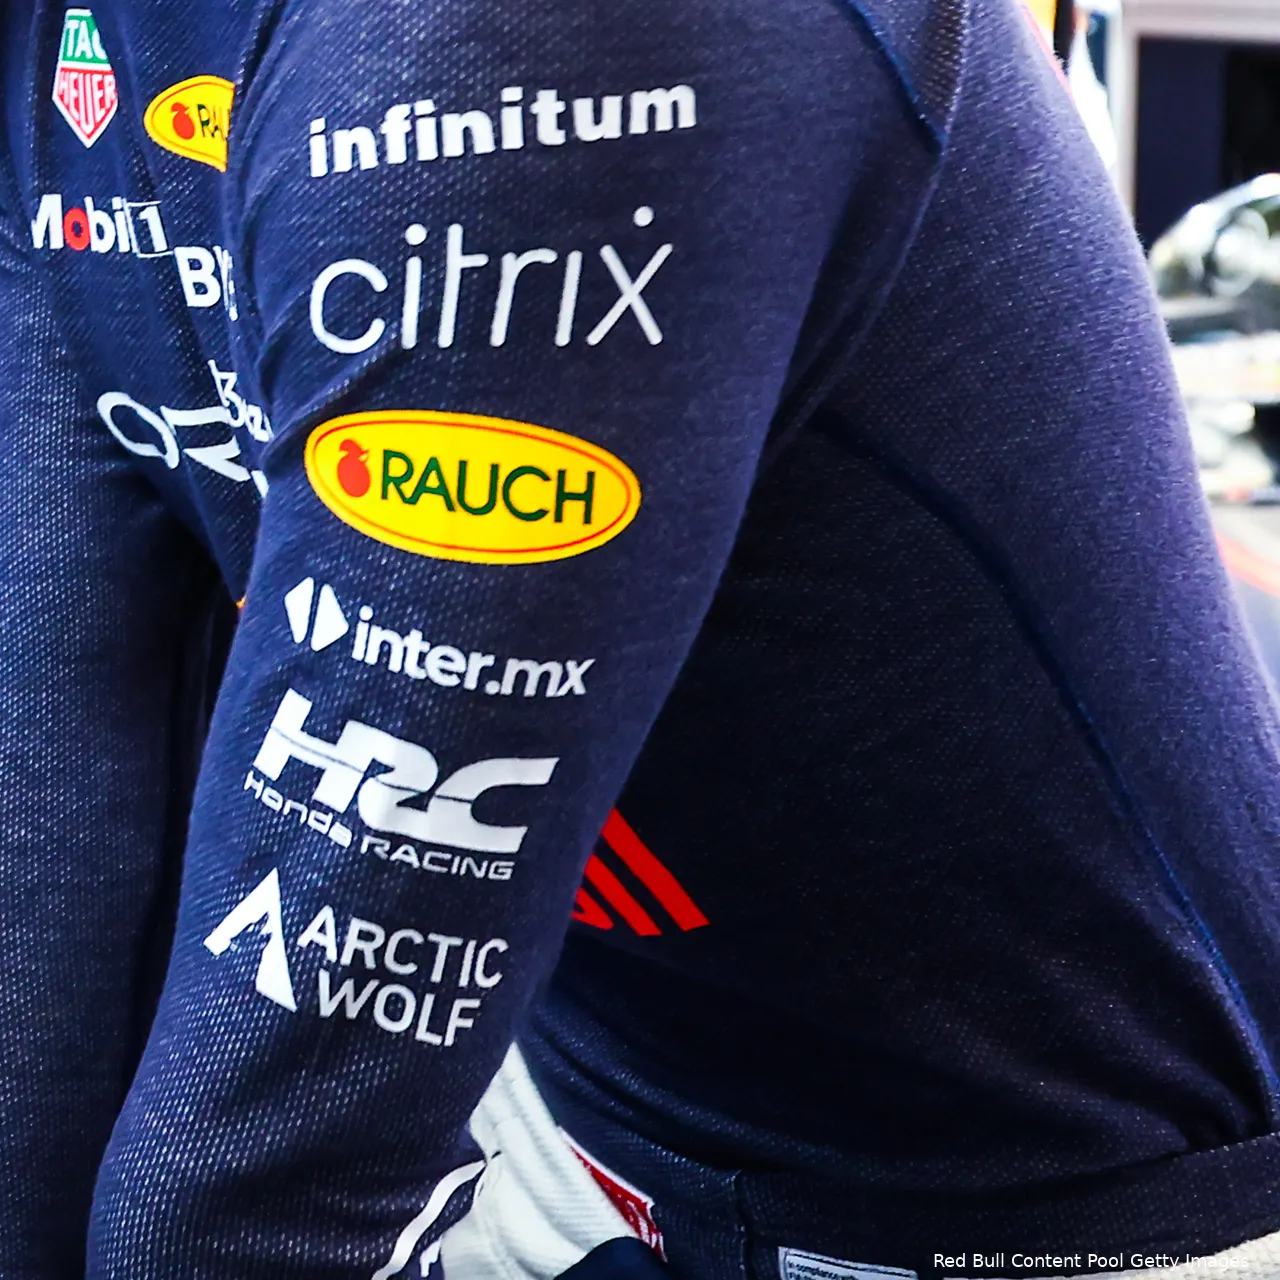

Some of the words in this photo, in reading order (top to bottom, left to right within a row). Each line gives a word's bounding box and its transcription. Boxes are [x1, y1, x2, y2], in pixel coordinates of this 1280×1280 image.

[57, 72, 117, 134] HEUER
[309, 84, 697, 178] infinitum
[309, 205, 674, 354] citrix
[381, 449, 596, 525] RAUCH
[351, 604, 596, 698] inter.mx
[252, 687, 561, 854] HRC
[243, 770, 353, 849] Honda
[359, 835, 515, 881] RACING
[297, 904, 510, 989] ARCTIC
[318, 968, 481, 1048] WOLF
